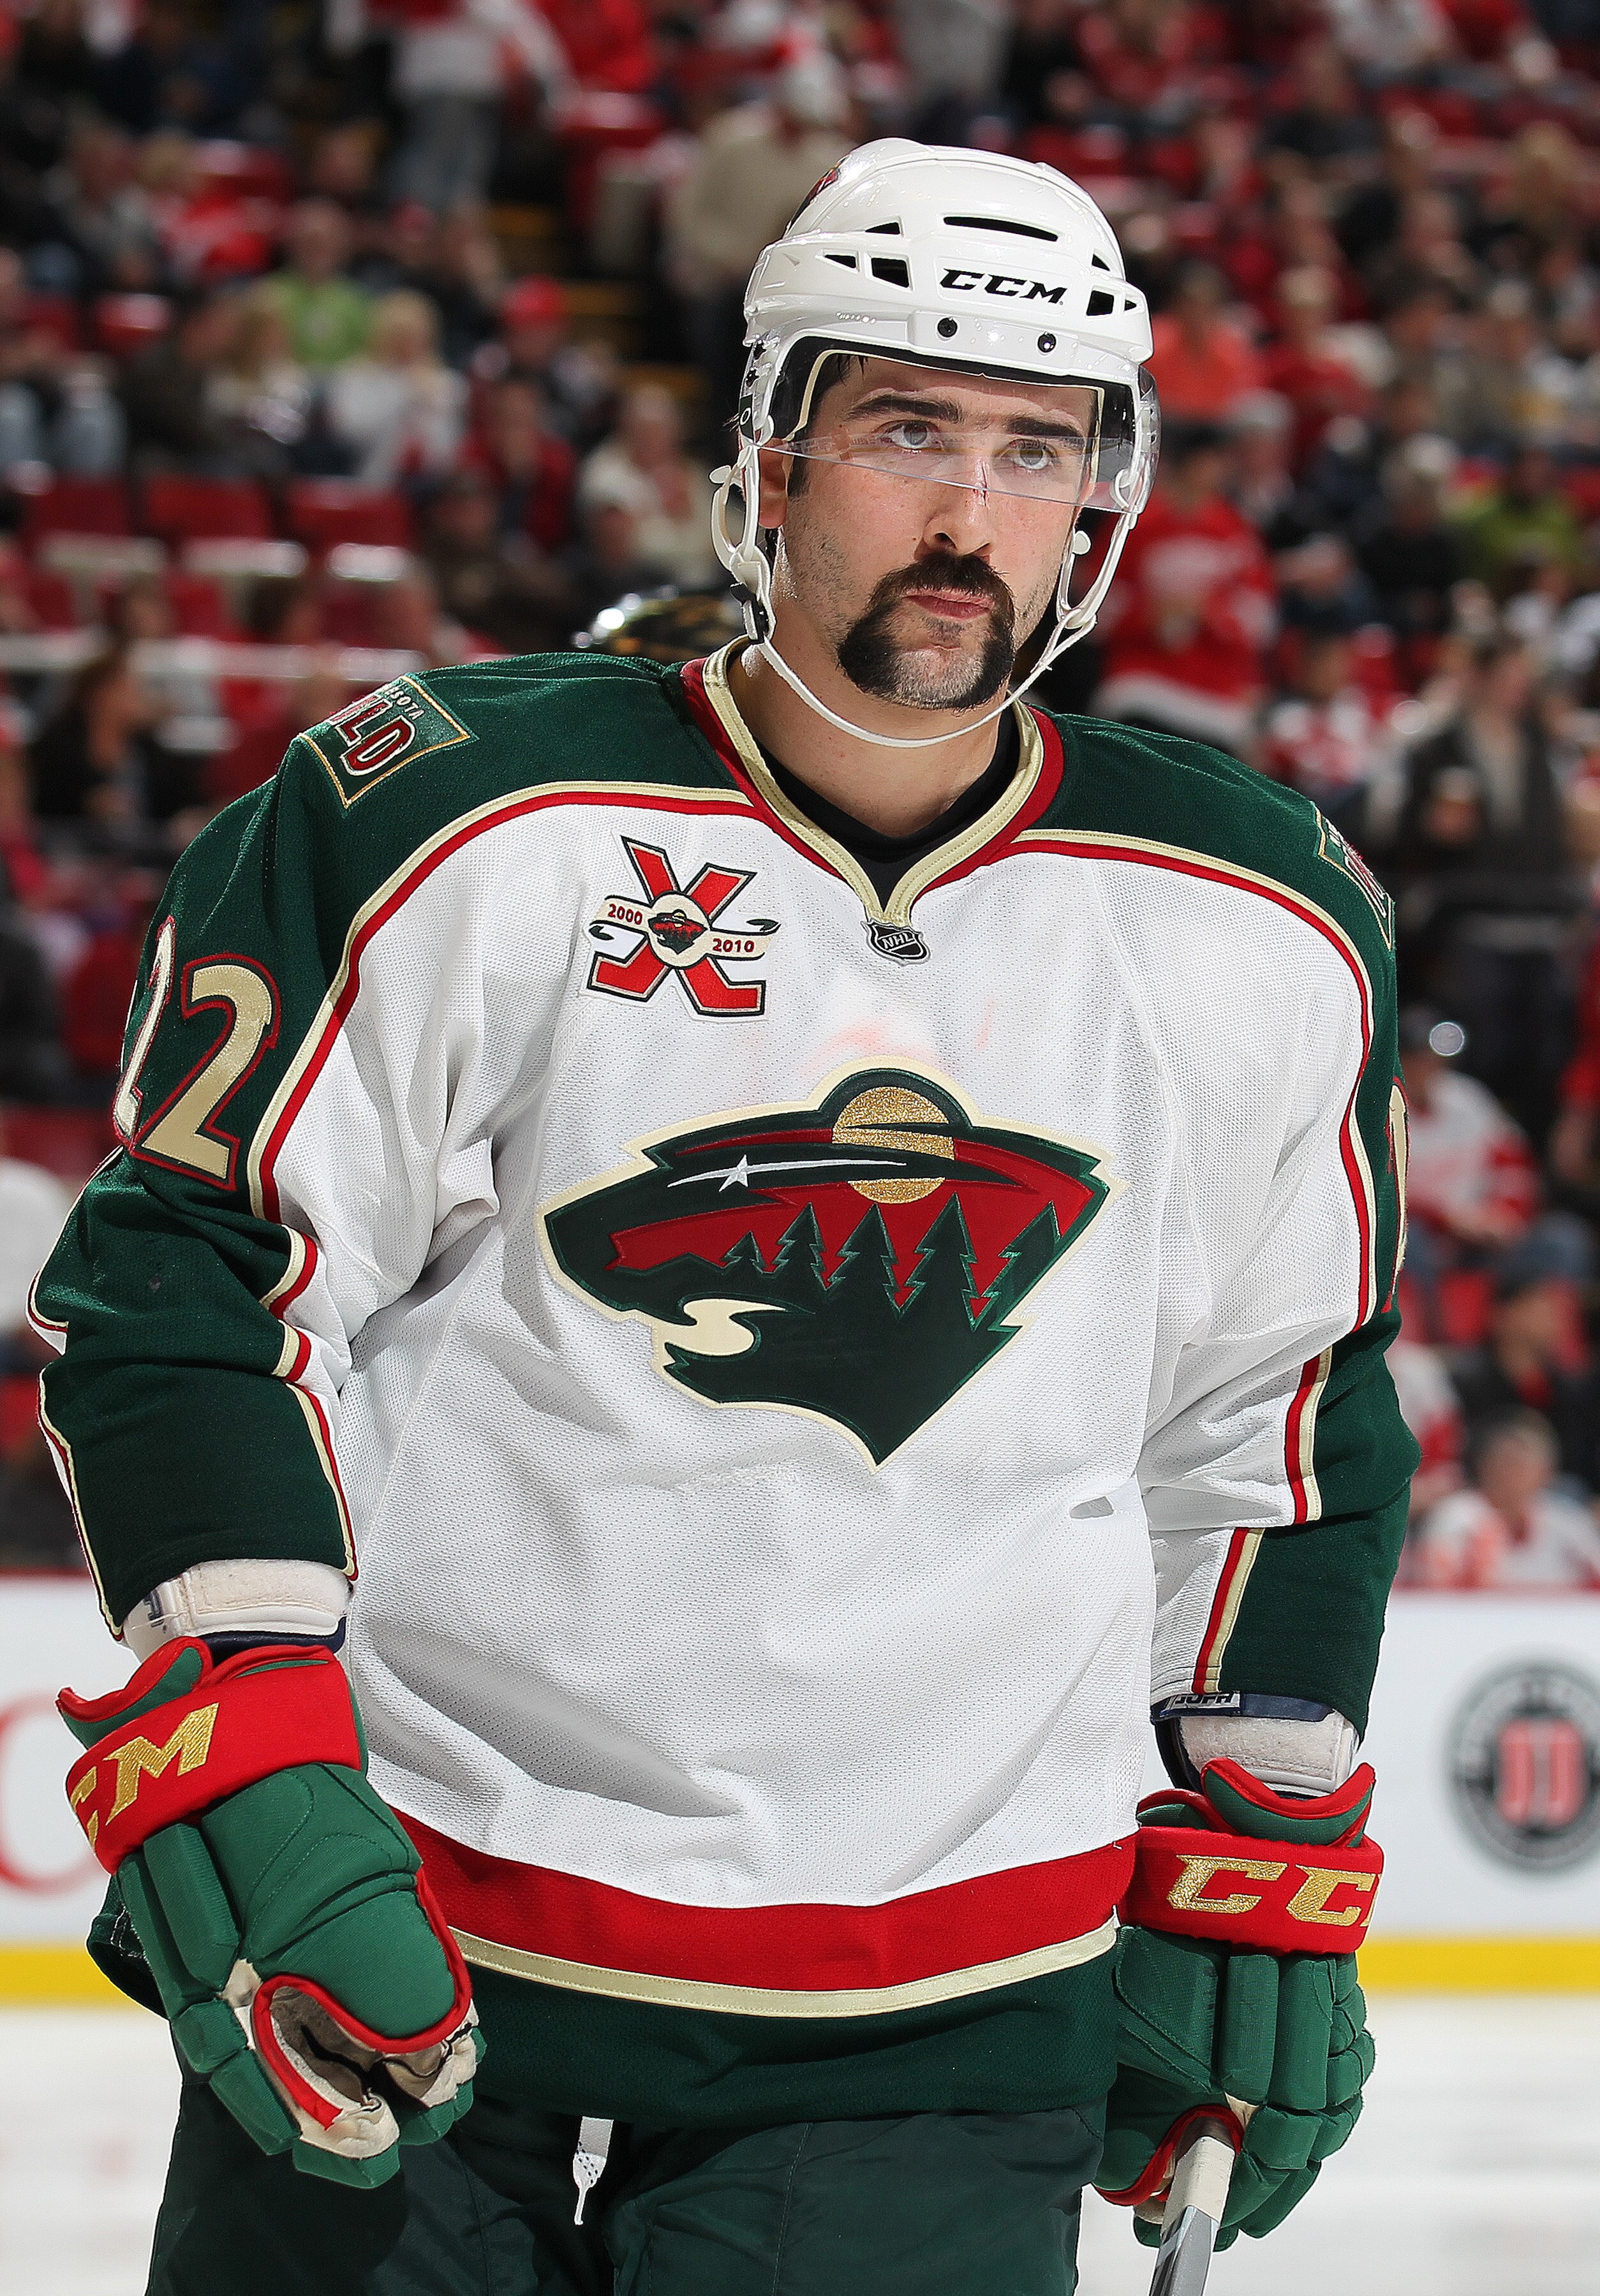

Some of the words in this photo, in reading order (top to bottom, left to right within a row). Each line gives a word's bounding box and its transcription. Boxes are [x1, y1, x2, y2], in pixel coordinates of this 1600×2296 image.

[940, 268, 1068, 304] CCM
[607, 903, 644, 925] 2000
[713, 938, 755, 953] 2010
[882, 932, 914, 950] NHL
[1166, 1855, 1382, 1927] CC
